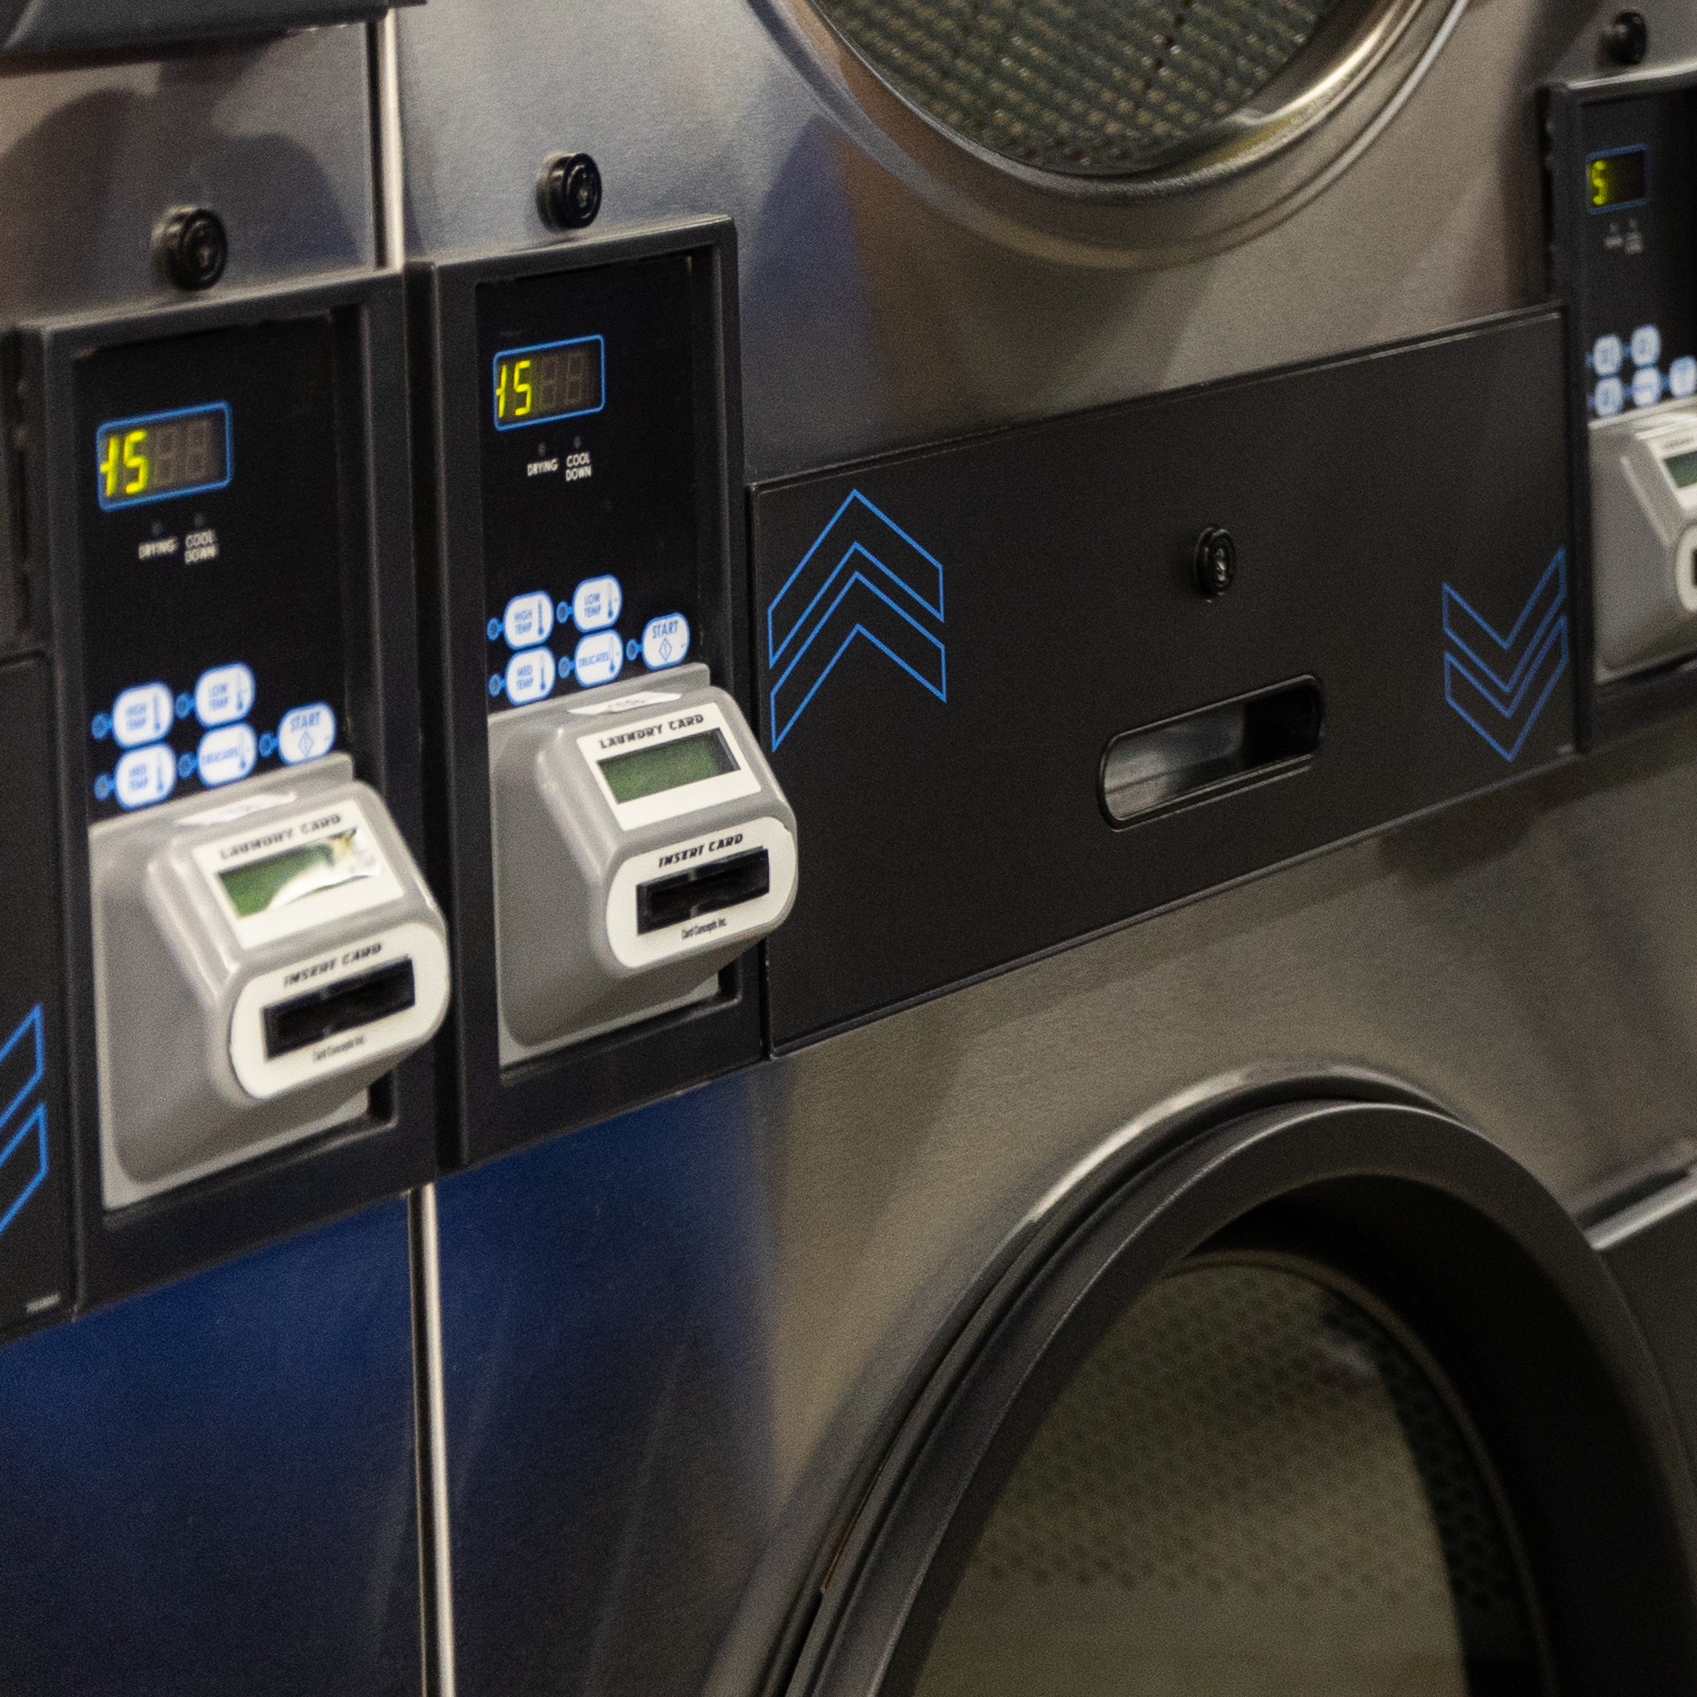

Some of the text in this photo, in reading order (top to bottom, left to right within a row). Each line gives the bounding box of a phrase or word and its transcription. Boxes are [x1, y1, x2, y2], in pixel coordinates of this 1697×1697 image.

[527, 458, 559, 477] DRYING
[566, 451, 591, 467] COOL
[565, 465, 592, 482] DOWN
[652, 619, 679, 639] START
[290, 711, 321, 733] START
[598, 713, 705, 750] LAUNDRY CARD
[219, 813, 342, 860] LAUNDRY CARD
[658, 833, 744, 869] INSERT CARD
[283, 942, 383, 988] INSERT CARD
